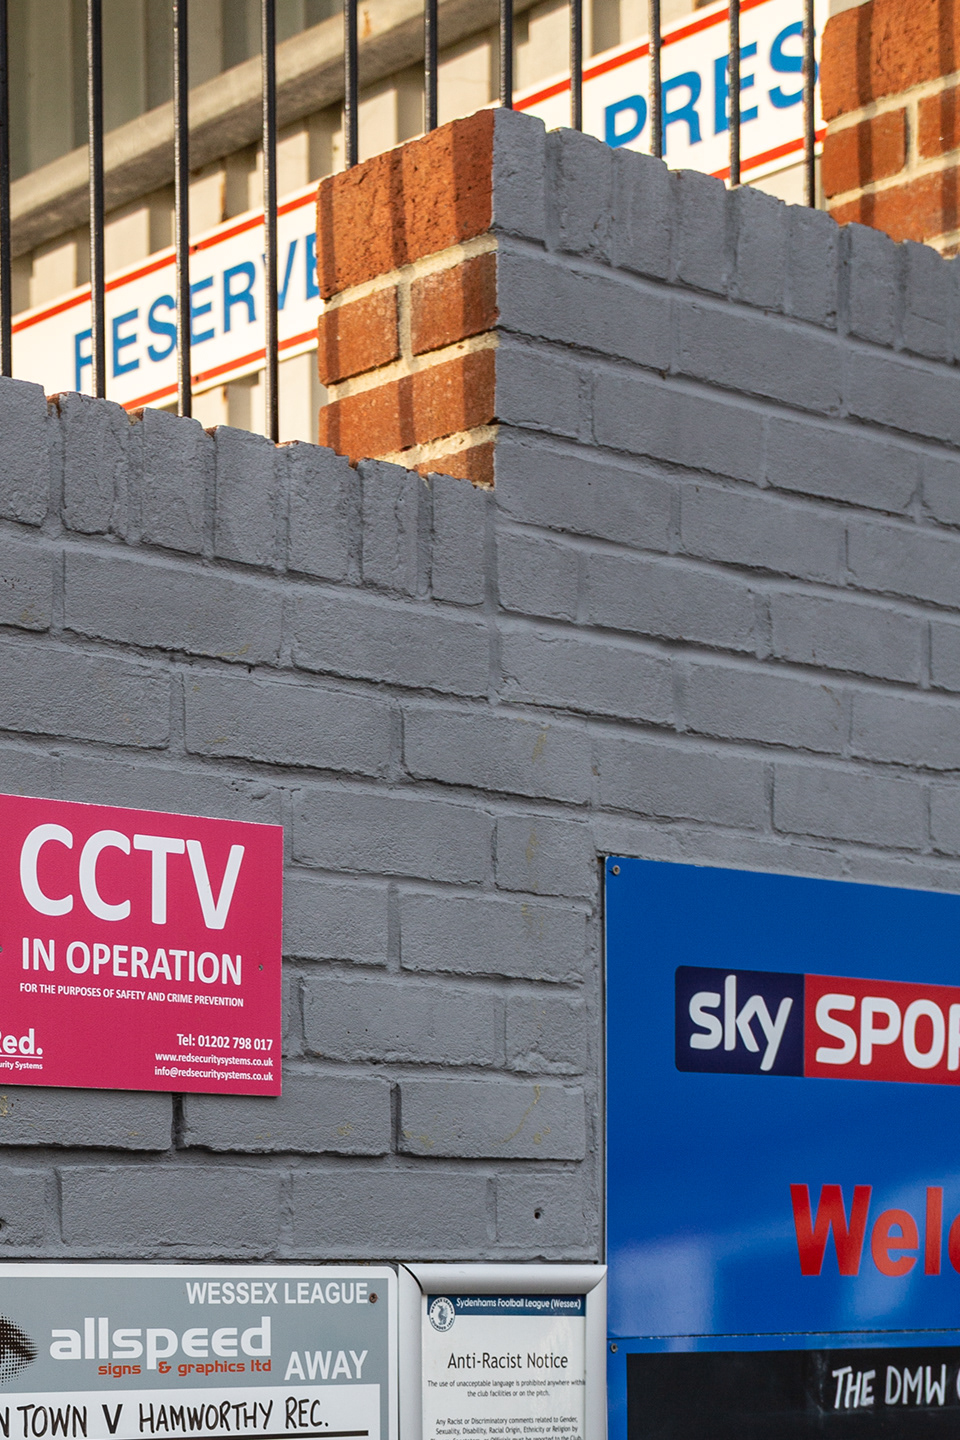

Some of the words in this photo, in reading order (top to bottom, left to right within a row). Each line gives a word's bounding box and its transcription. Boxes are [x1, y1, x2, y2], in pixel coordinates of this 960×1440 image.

[19, 823, 245, 930] CCTV
[21, 936, 55, 972] IN
[65, 940, 243, 985] OPERATION
[19, 982, 38, 993] FOR
[39, 983, 56, 995] THE
[57, 985, 102, 998] PURPOSES
[103, 988, 115, 999] OF
[116, 989, 146, 1001] SAFETY
[147, 991, 166, 1002] AND
[167, 993, 193, 1004] CRIME
[194, 995, 244, 1008] PREVENTION
[688, 974, 794, 1072] sky
[176, 1033, 196, 1047] Tel:
[197, 1034, 230, 1049] 01202
[232, 1036, 252, 1050] 798
[253, 1038, 273, 1051] 017
[15, 1060, 43, 1071] Systems
[154, 1066, 274, 1081] info@redsecuritysystems.co.uk
[155, 1052, 274, 1067] www.redsecuritysystems.co.uk
[790, 1183, 960, 1277] Wel
[186, 1282, 278, 1304] WESSEX
[284, 1282, 368, 1304] LEAGUE
[49, 1316, 272, 1370] allspeed
[98, 1363, 141, 1378] signs
[158, 1361, 172, 1374] &
[177, 1360, 246, 1377] graphics
[250, 1359, 272, 1373] ltd
[284, 1350, 369, 1380] AWAY
[447, 1352, 522, 1369] Anti-Racist
[527, 1352, 569, 1369] Notice
[831, 1365, 876, 1409] THE
[884, 1363, 946, 1406] DMW
[17, 1404, 88, 1438] TOWN
[101, 1403, 123, 1435] V
[138, 1399, 273, 1433] HAMWORTHY
[285, 1396, 329, 1429] REC.
